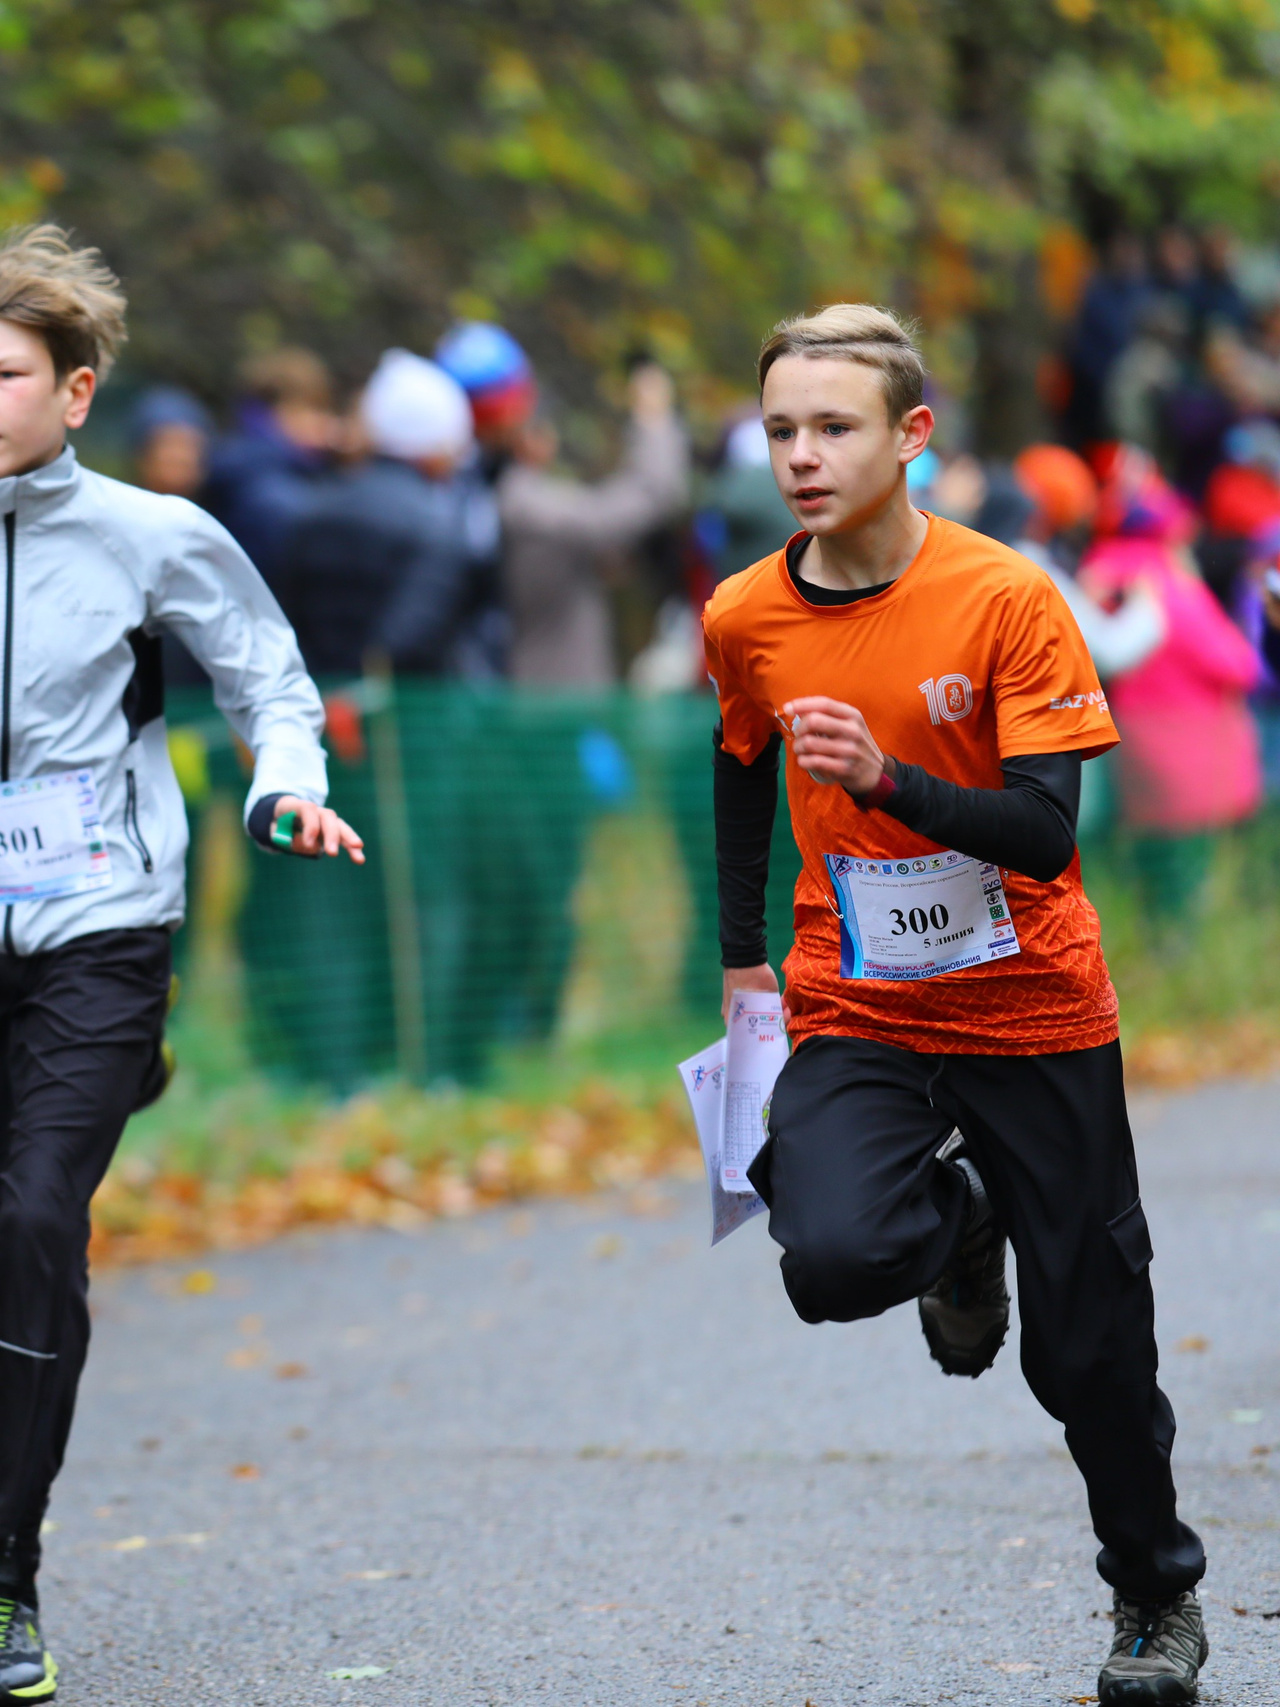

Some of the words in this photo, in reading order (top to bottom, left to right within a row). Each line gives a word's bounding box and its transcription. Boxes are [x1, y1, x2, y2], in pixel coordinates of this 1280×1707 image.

[918, 673, 973, 726] 10
[888, 903, 950, 936] 300
[923, 938, 932, 949] 5
[934, 926, 975, 947] линия
[921, 954, 982, 979] СОРЕВНОВАНИЯ
